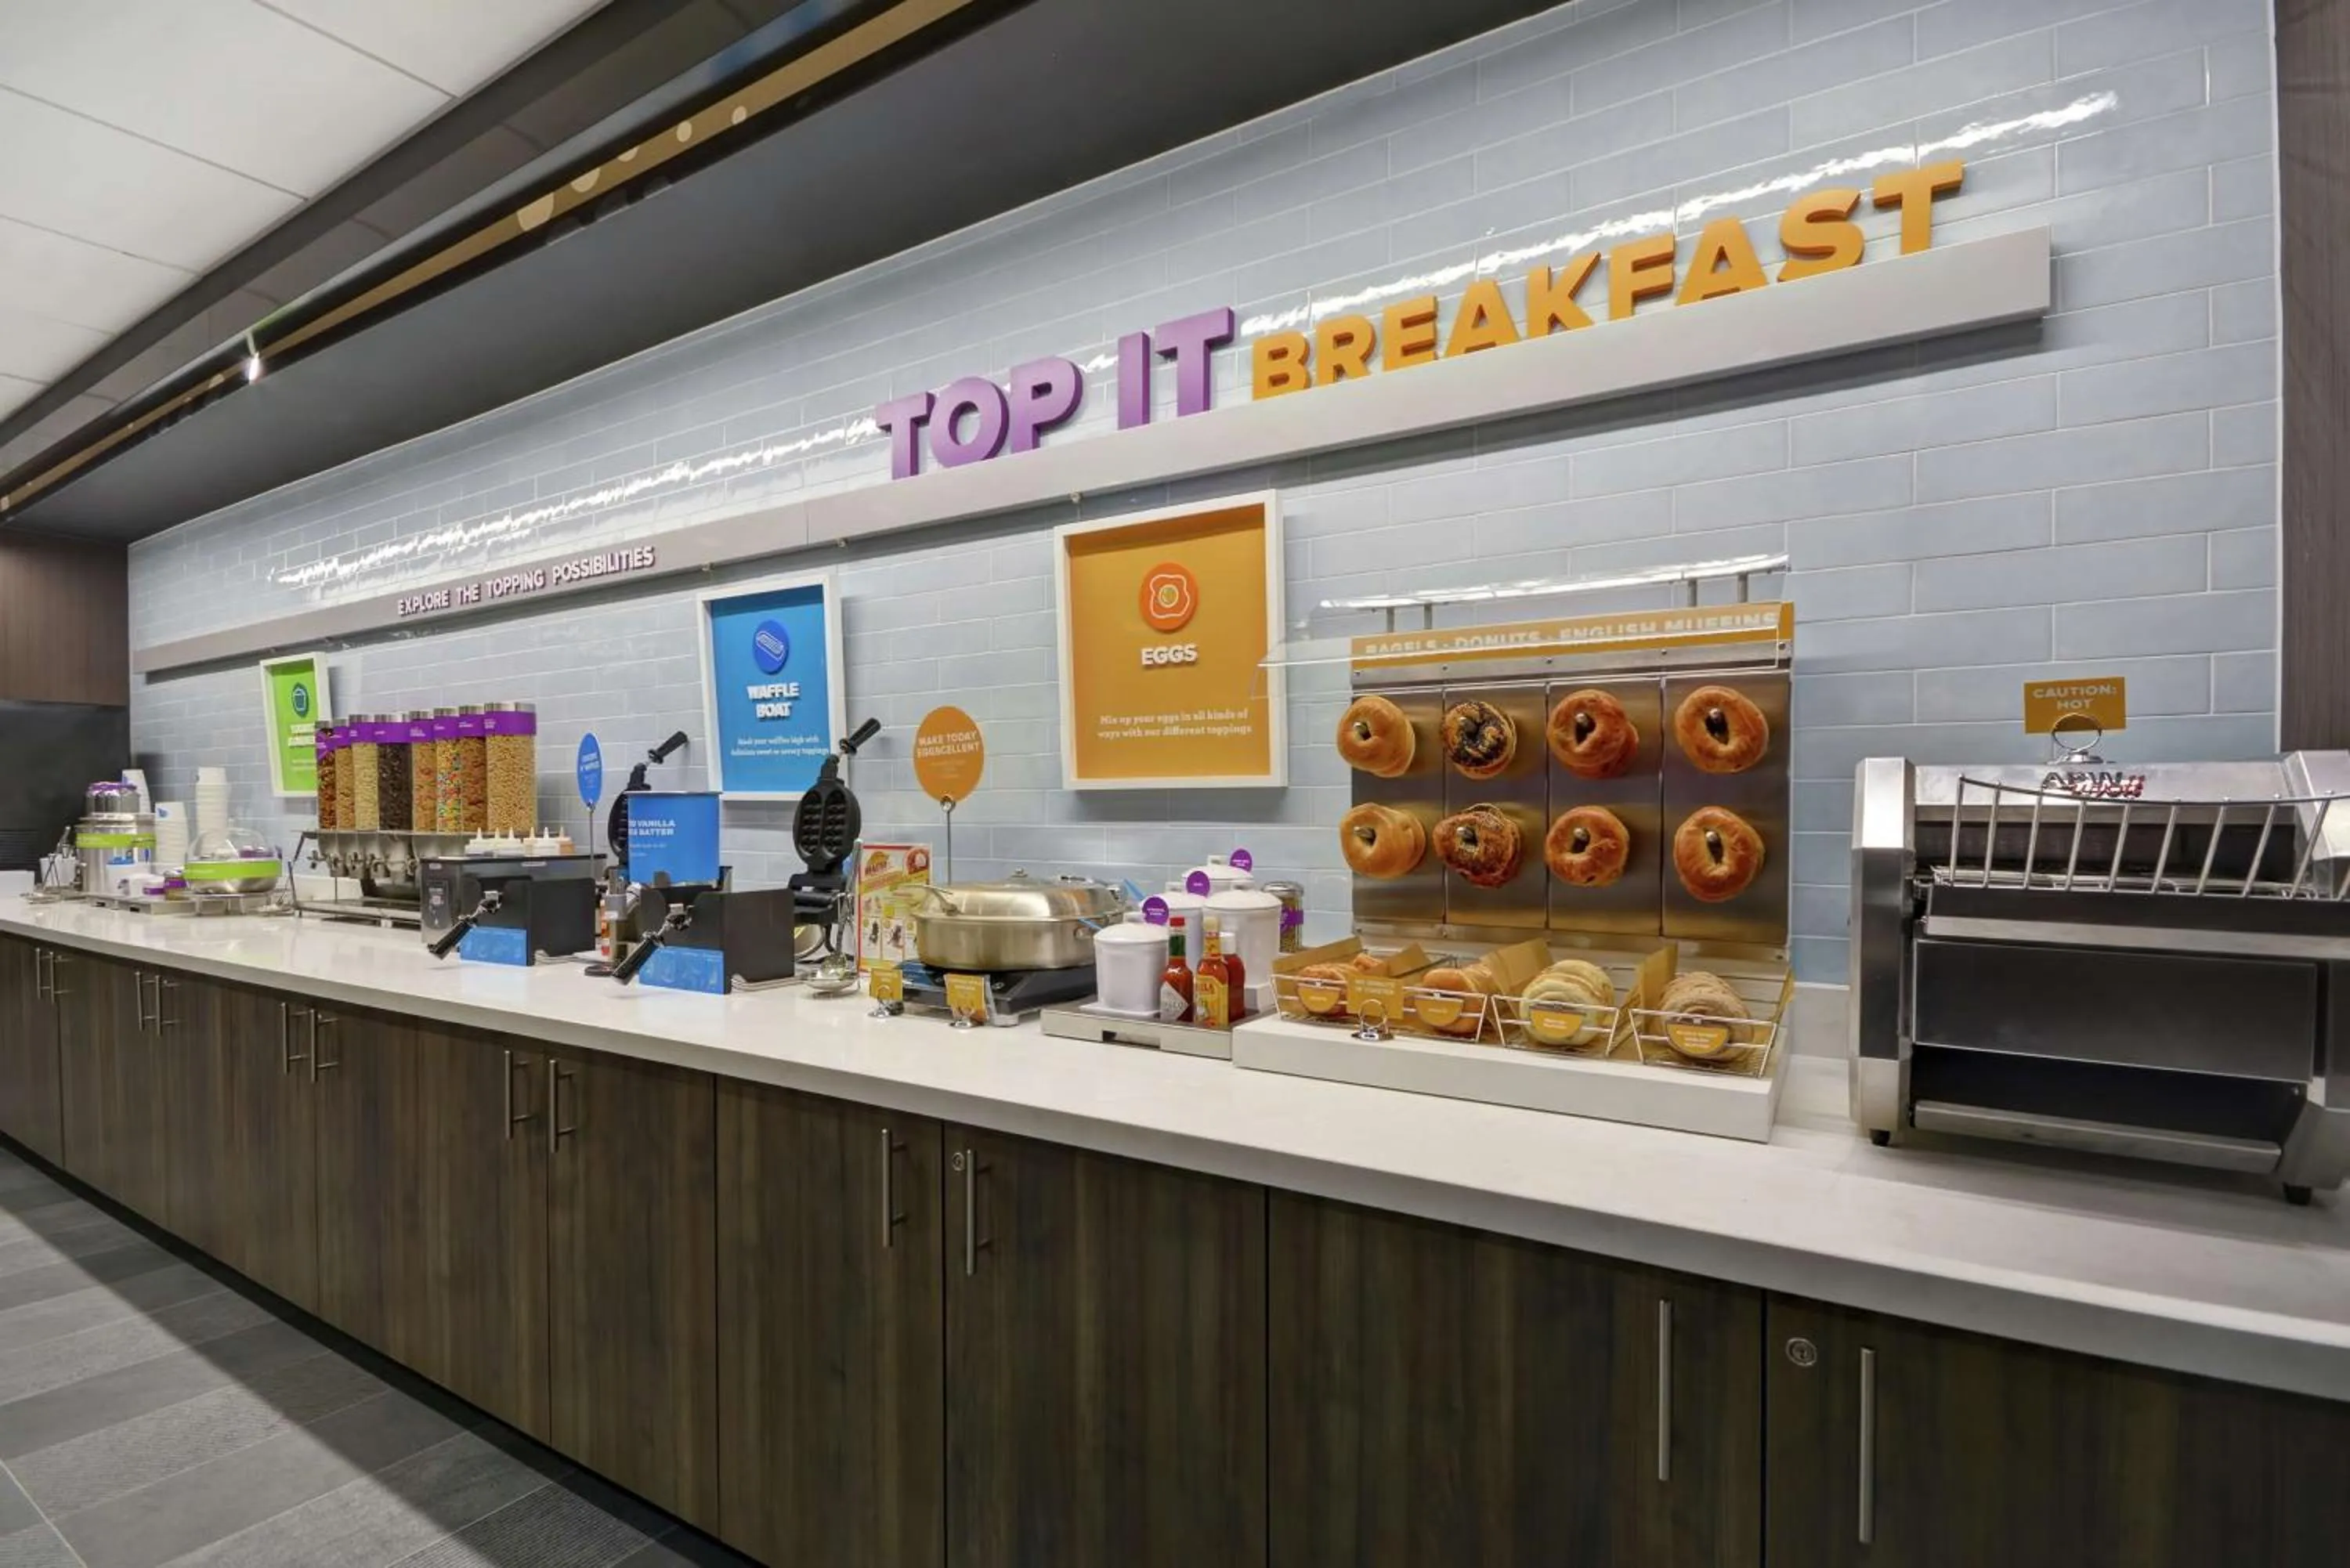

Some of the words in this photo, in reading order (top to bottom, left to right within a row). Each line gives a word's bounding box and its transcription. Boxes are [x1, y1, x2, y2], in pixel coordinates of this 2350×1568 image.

[877, 356, 1083, 480] TOP
[1118, 306, 1235, 430] IT
[1252, 159, 1965, 401] BREAKFAST
[397, 590, 450, 616] EXPLORE
[456, 583, 481, 605] THE
[486, 570, 545, 598] TOPPING
[552, 546, 655, 584] POSSIBILITIES
[1365, 639, 1437, 655] BAGELS
[1455, 630, 1541, 649] DONUTS
[1560, 621, 1657, 640] ENGLISH
[1664, 612, 1778, 632] MUFFINS
[1141, 644, 1198, 667] EGGS
[747, 682, 801, 699] WAFFLE
[2033, 684, 2117, 699] CAUTION:
[756, 702, 792, 718] BOAT
[2057, 699, 2094, 710] HOT
[1133, 714, 1155, 727] your
[1157, 714, 1179, 725] eggs
[1207, 708, 1235, 719] kinds
[1237, 707, 1249, 719] of
[918, 734, 944, 747] MAKE
[946, 729, 978, 743] TODAY
[1122, 727, 1141, 737] with
[1162, 724, 1205, 735] different
[638, 828, 674, 836] BATTER
